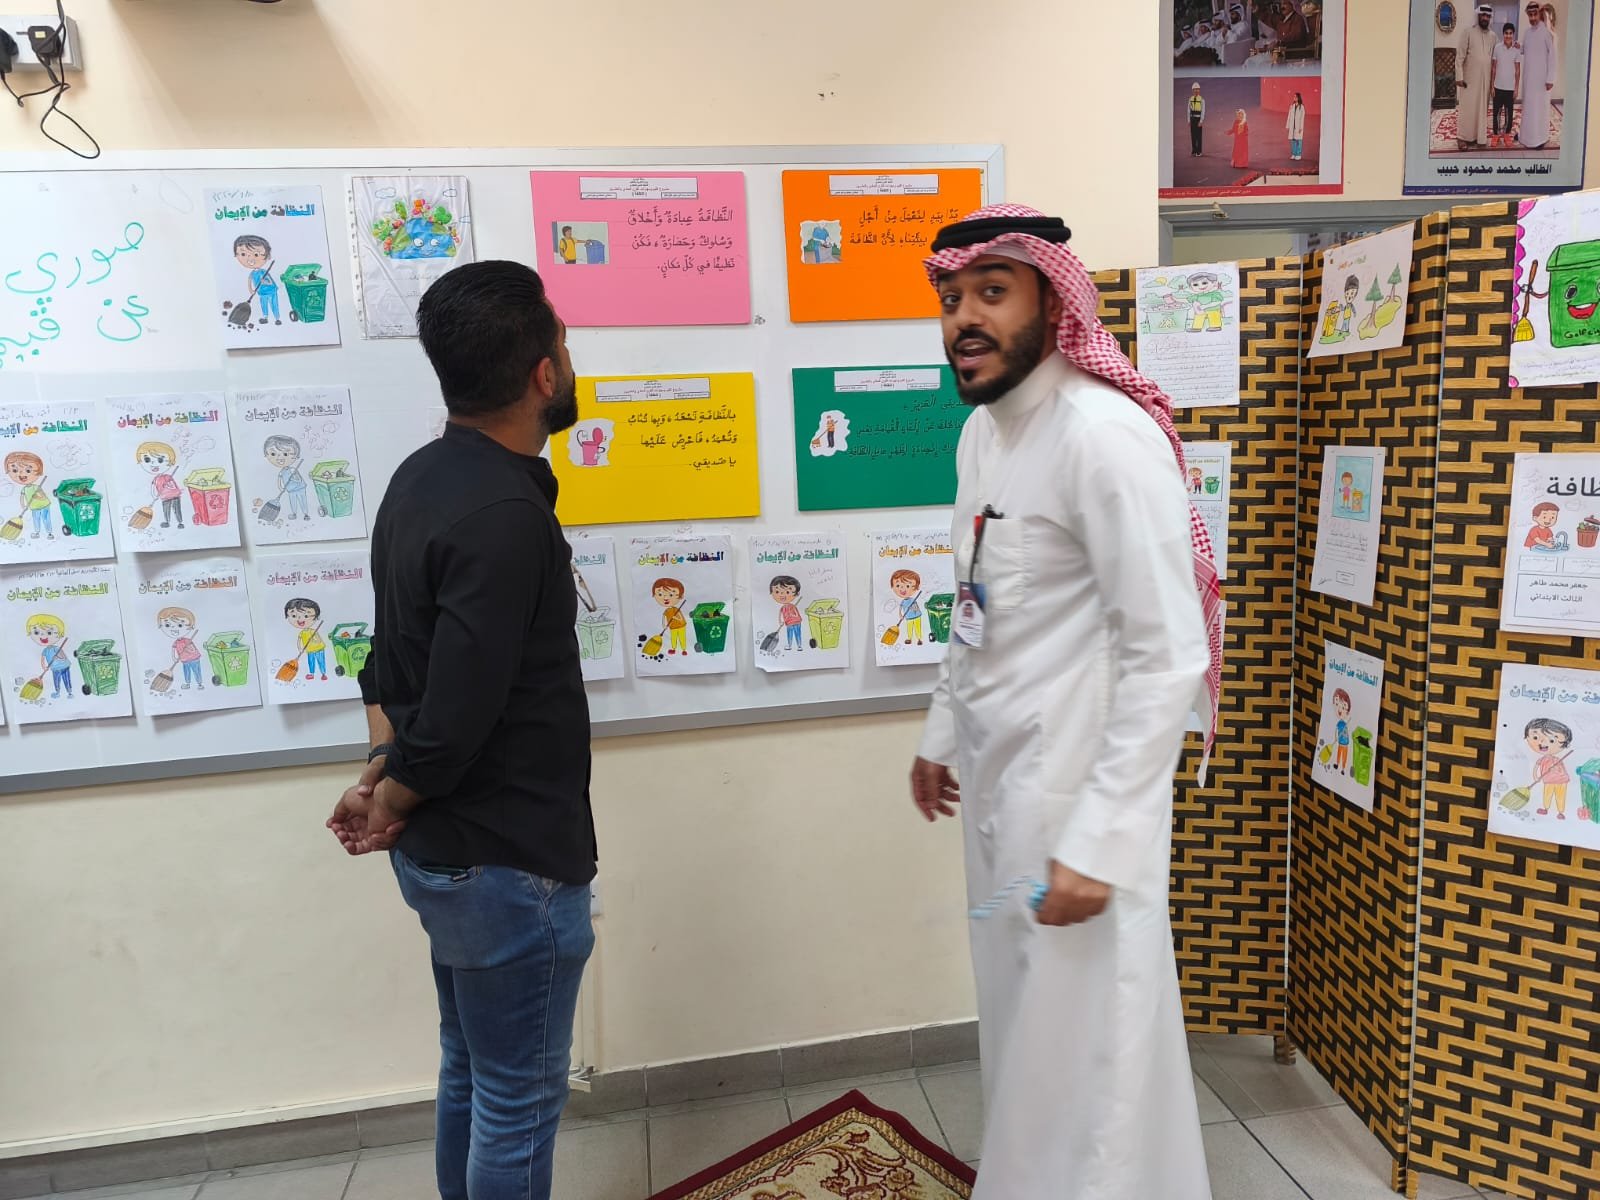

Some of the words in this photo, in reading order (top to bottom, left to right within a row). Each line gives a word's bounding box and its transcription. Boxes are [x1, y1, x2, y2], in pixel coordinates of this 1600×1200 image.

[1437, 164, 1459, 177] حبيب
[1462, 164, 1493, 177] محمود
[1497, 164, 1522, 175] محمد
[1525, 163, 1552, 176] الطالب
[215, 206, 250, 220] الإيمان
[252, 207, 268, 219] من
[270, 204, 315, 218] النظافة
[6, 222, 145, 306] صوري
[174, 408, 219, 424] النظافة
[244, 406, 280, 422] الإيمان
[281, 407, 297, 420] من
[298, 403, 343, 417] النظافة
[41, 418, 88, 433] النظافة
[117, 412, 153, 429] الإيمان
[155, 413, 172, 427] من
[22, 423, 39, 436] من
[686, 551, 724, 562] النظافة
[787, 551, 802, 562] من
[802, 547, 839, 560] النظافة
[878, 543, 908, 559] الإيمان
[908, 546, 922, 556] من
[923, 544, 955, 555] نظافة
[637, 553, 669, 567] الإيمان
[670, 554, 684, 565] من
[756, 549, 787, 565] الإيمان
[266, 570, 301, 586] الإيمان
[303, 572, 319, 583] من
[320, 567, 363, 581] النظافة
[64, 582, 109, 596] النظافة
[138, 579, 174, 595] الإيمان
[175, 580, 192, 592] من
[193, 575, 238, 589] النظافة
[1548, 581, 1569, 589] محمد
[7, 586, 43, 602] الإيمان
[44, 587, 61, 599] من
[1557, 689, 1579, 704] من
